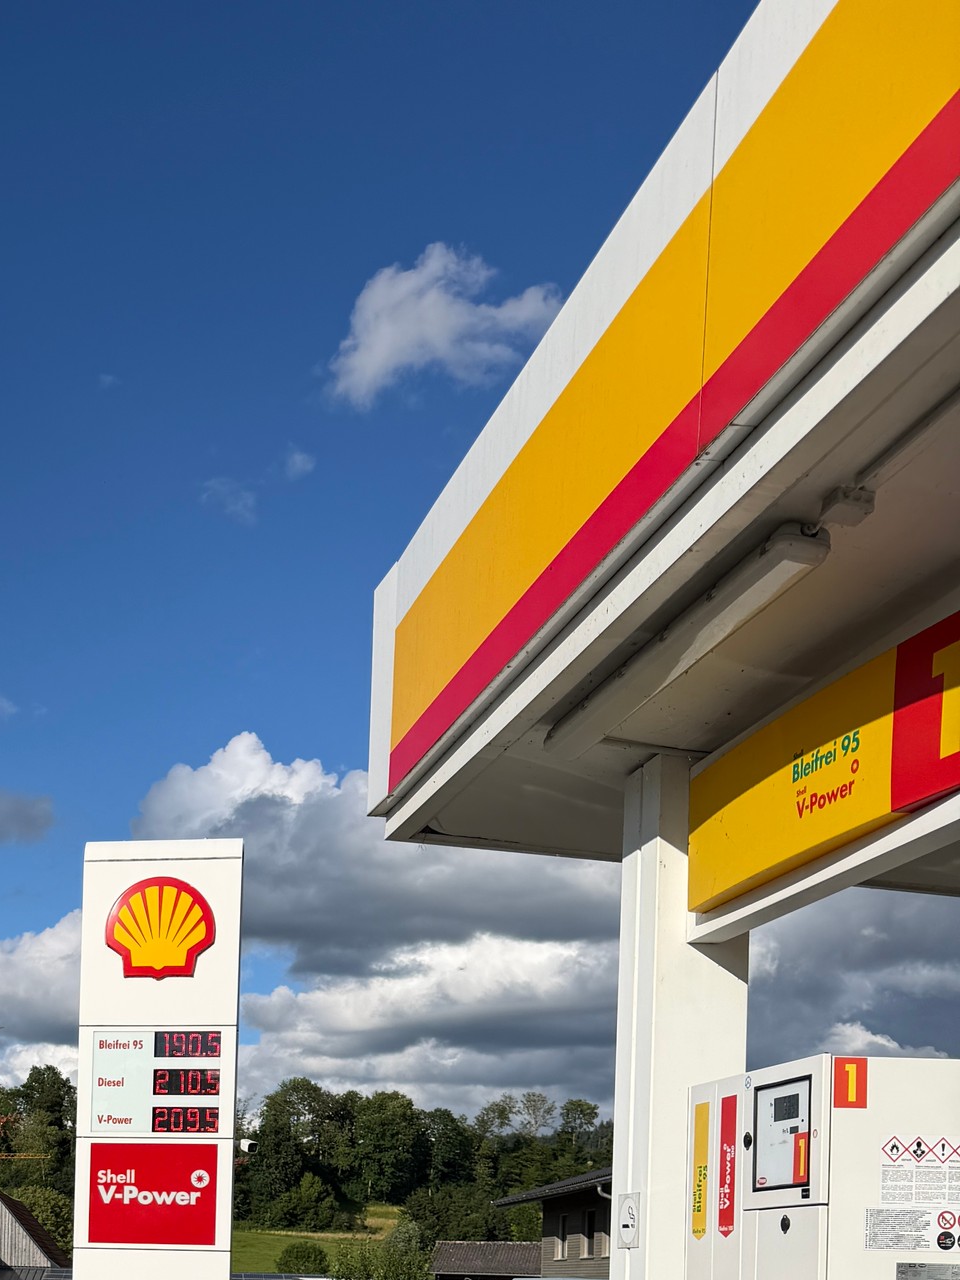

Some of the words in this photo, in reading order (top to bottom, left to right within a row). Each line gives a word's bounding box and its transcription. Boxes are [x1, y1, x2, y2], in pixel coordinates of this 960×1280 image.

[932, 640, 960, 759] 1
[792, 740, 837, 784] Bleifrei
[841, 730, 860, 757] 95
[796, 786, 807, 797] Shell
[796, 779, 855, 819] V-Power
[98, 1039, 130, 1050] Bleifrei
[133, 1040, 144, 1050] 95
[164, 1033, 221, 1057] 190.5
[97, 1077, 125, 1087] Diesel
[845, 1063, 857, 1102] 1
[97, 1114, 133, 1125] V-Power
[154, 1108, 219, 1132] 209.5
[798, 1138, 805, 1176] 1
[97, 1169, 135, 1184] Shell
[723, 1145, 731, 1210] V-Power
[97, 1185, 201, 1206] V-Power
